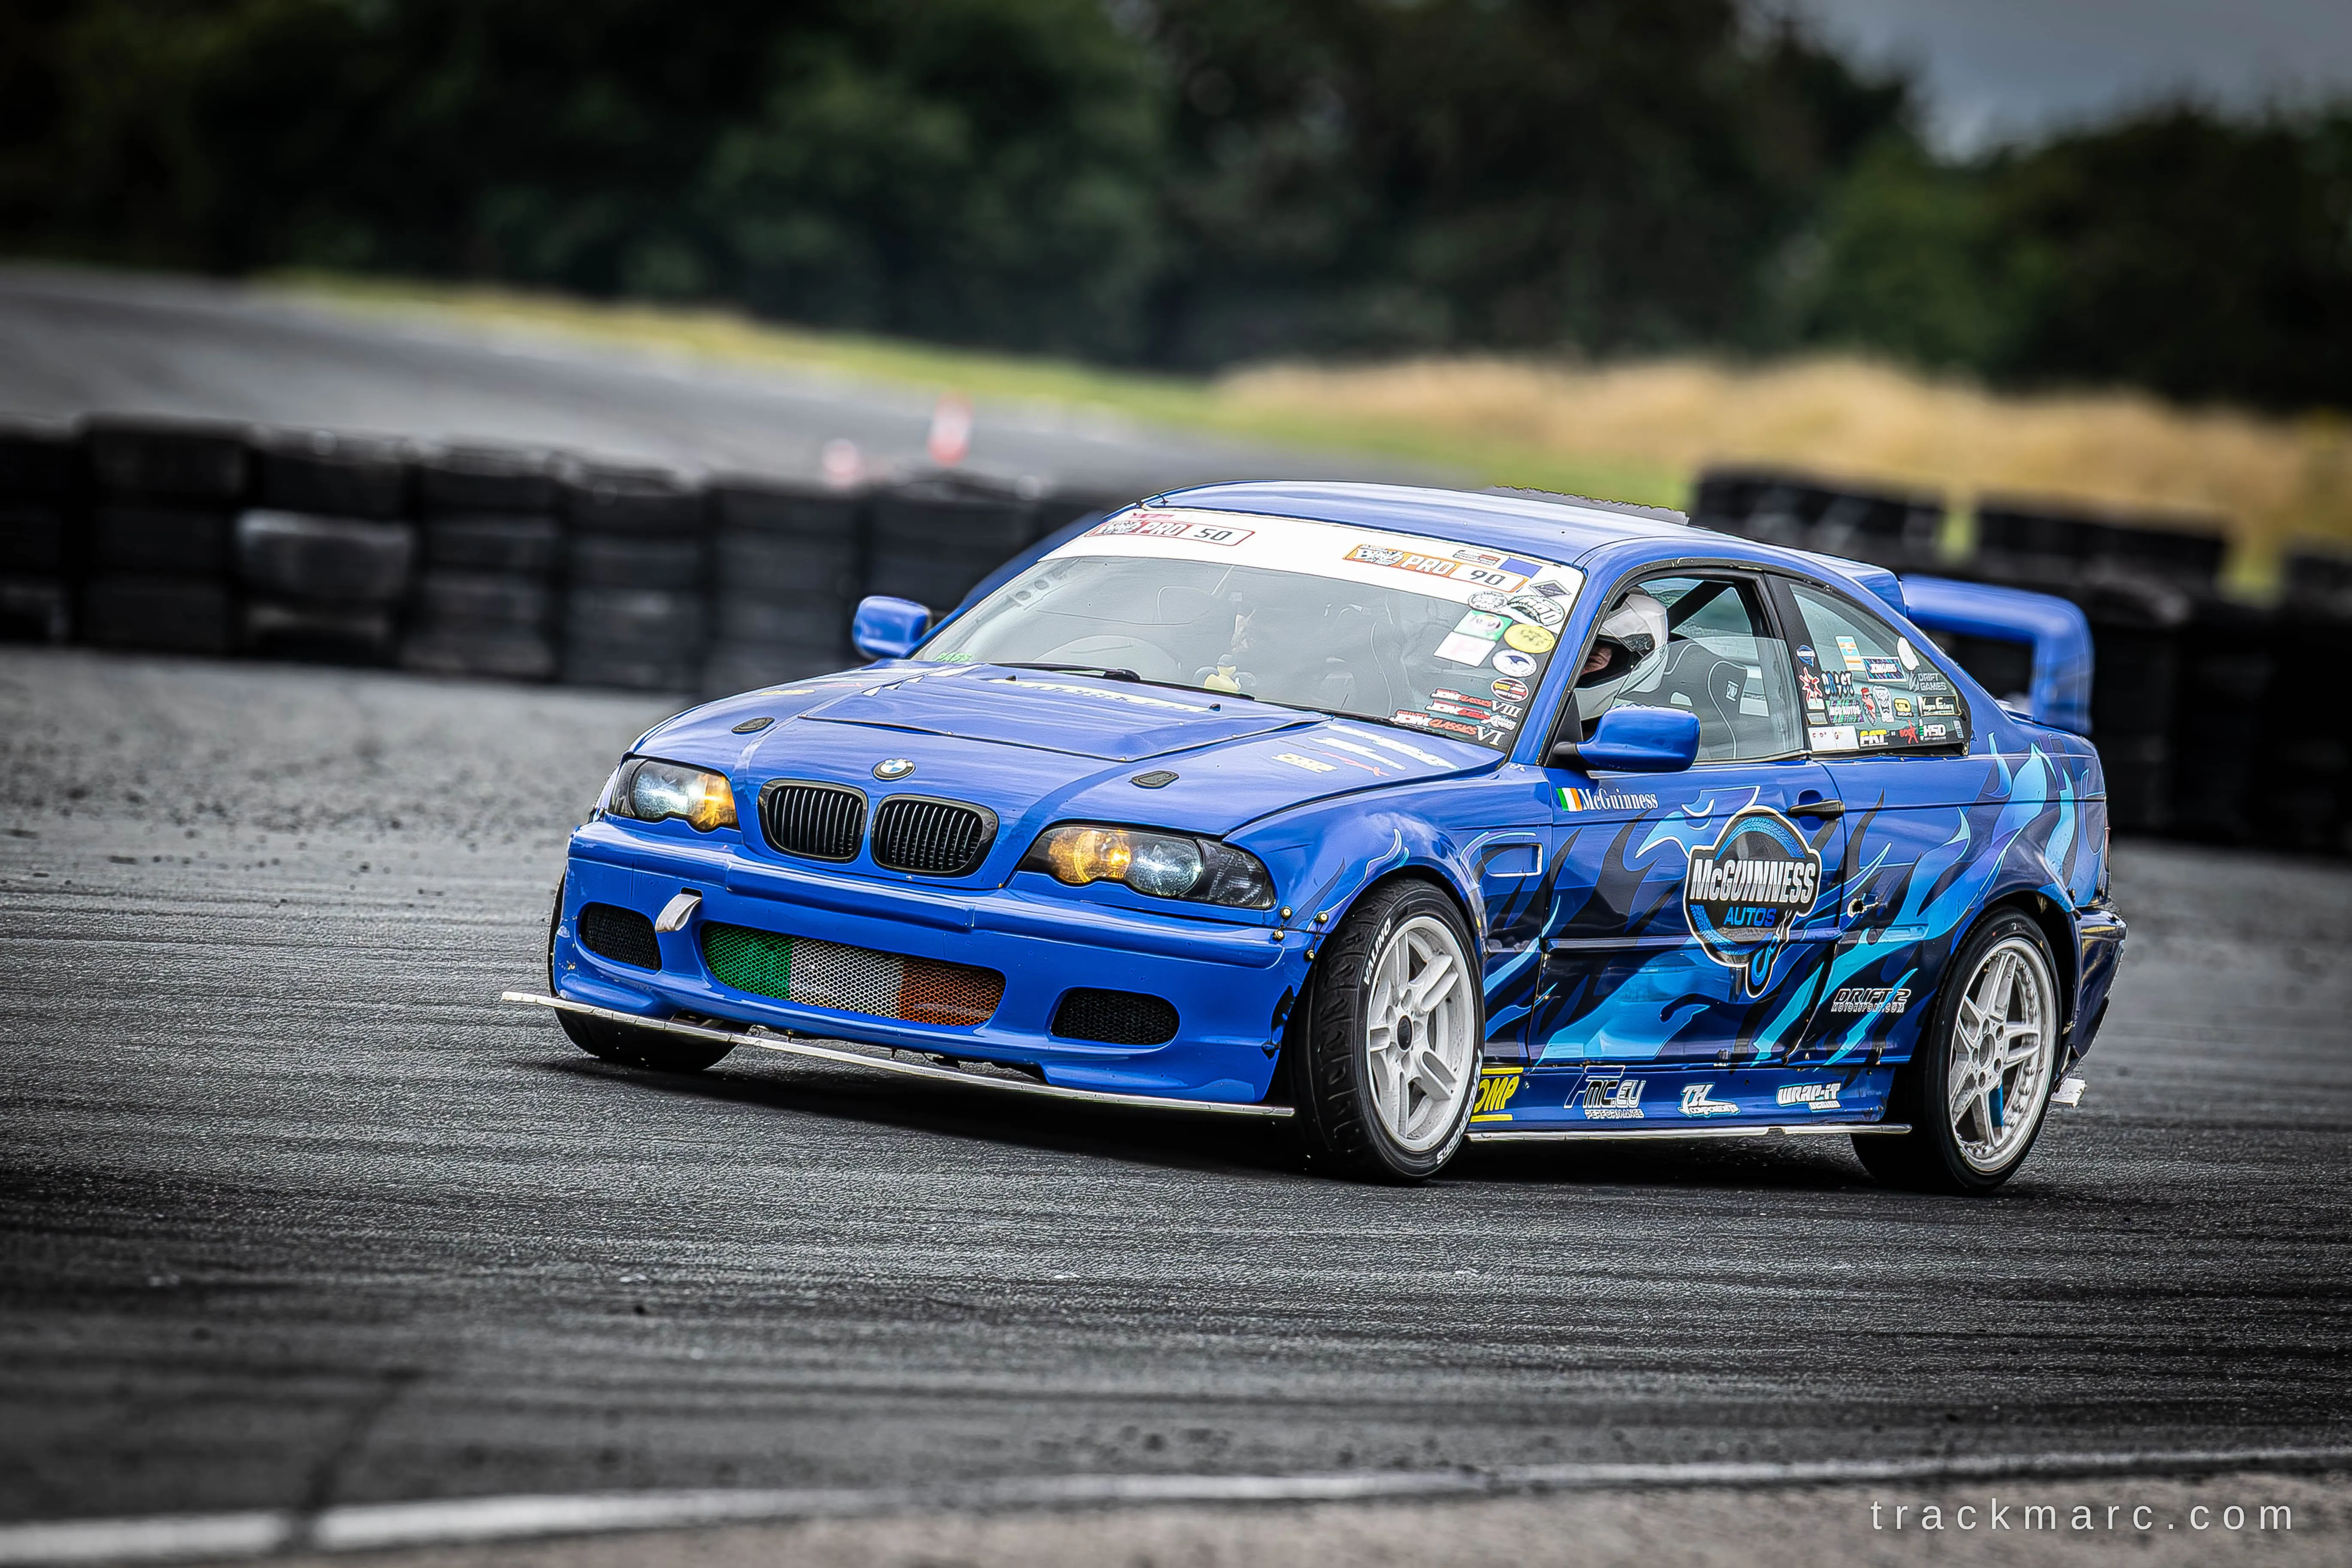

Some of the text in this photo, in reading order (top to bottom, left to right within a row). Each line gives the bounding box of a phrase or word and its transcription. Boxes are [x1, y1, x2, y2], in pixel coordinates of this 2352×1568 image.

[1135, 520, 1189, 537] PRO
[1194, 528, 1233, 541] 50
[1400, 554, 1456, 575] PRO
[1470, 570, 1506, 585] 90
[1920, 682, 1947, 691] GAMES
[1492, 699, 1523, 717] VIII
[1389, 714, 1432, 727] JDM
[1428, 719, 1477, 735] CLASSICS
[1476, 725, 1505, 746] VI
[1582, 788, 1658, 811] McGuinness
[1689, 858, 1816, 903] McGUINNESS
[1723, 907, 1777, 927] AUTOS
[1364, 917, 1391, 985] VALINO
[1833, 988, 1911, 1003] DRIFT 2
[1474, 1076, 1519, 1113] OMP
[1584, 1109, 1644, 1119] PERFORMANCE
